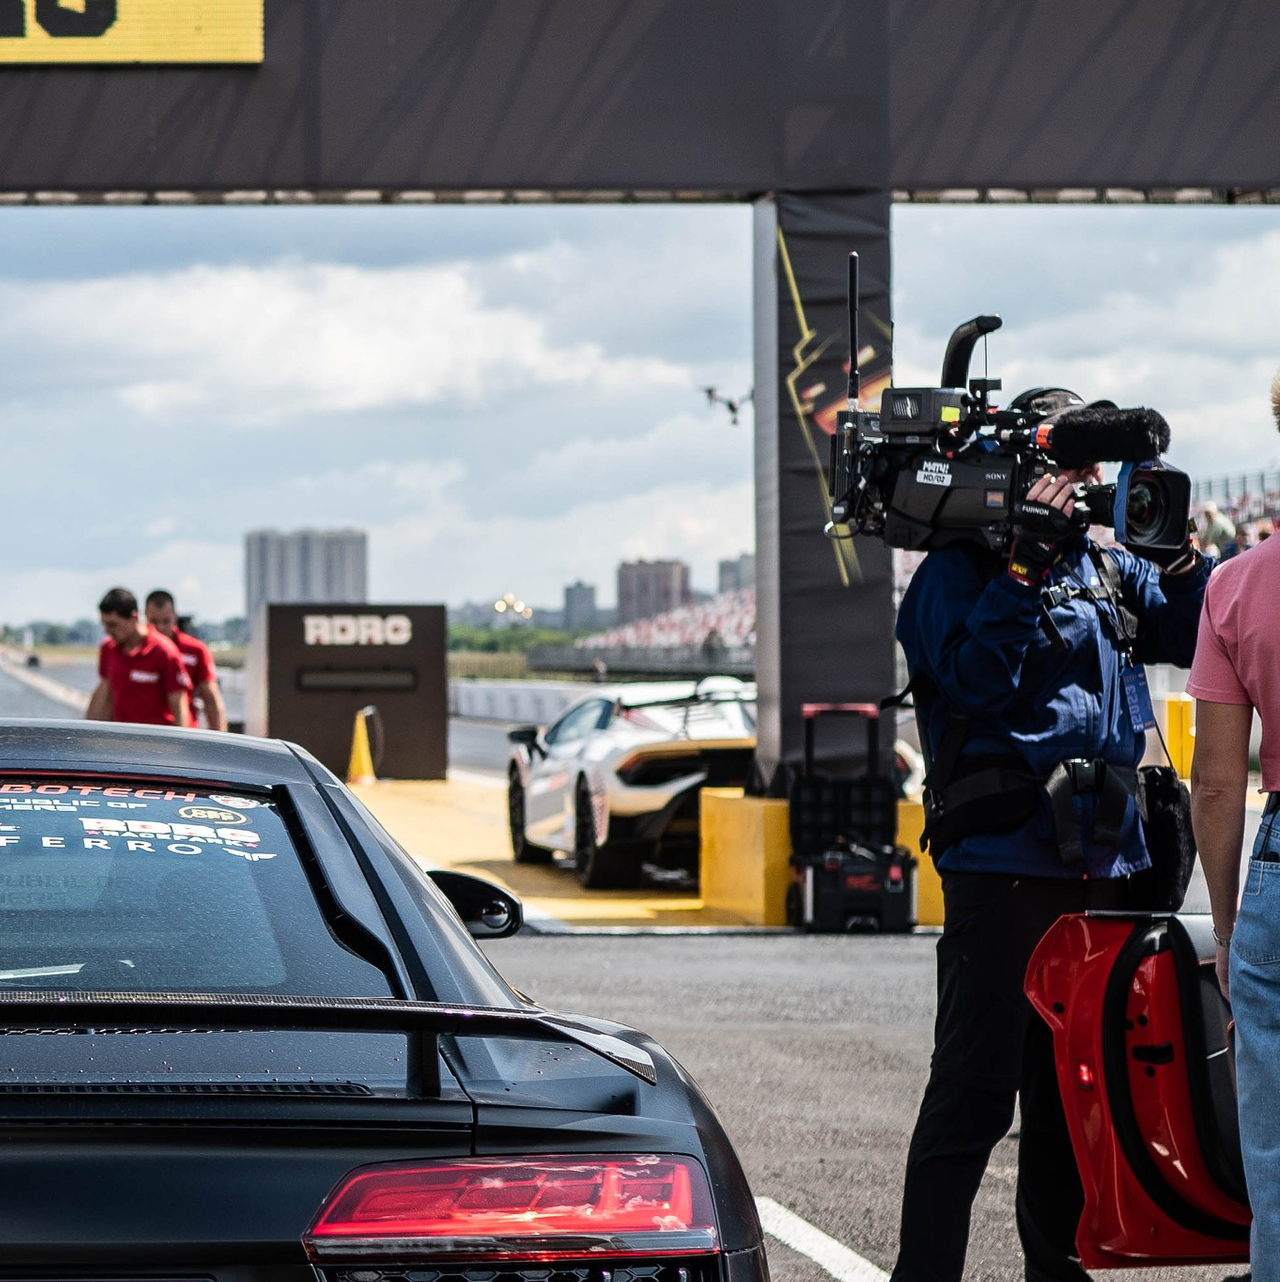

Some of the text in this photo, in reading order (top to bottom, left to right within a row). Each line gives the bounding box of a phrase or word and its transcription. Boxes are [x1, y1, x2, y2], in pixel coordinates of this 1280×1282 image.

[985, 473, 1007, 481] SONY
[1022, 505, 1050, 516] FUJINON
[303, 614, 412, 645] RDRC
[106, 801, 148, 809] OF
[78, 817, 261, 842] RDRC
[103, 830, 243, 848] RACEPARK
